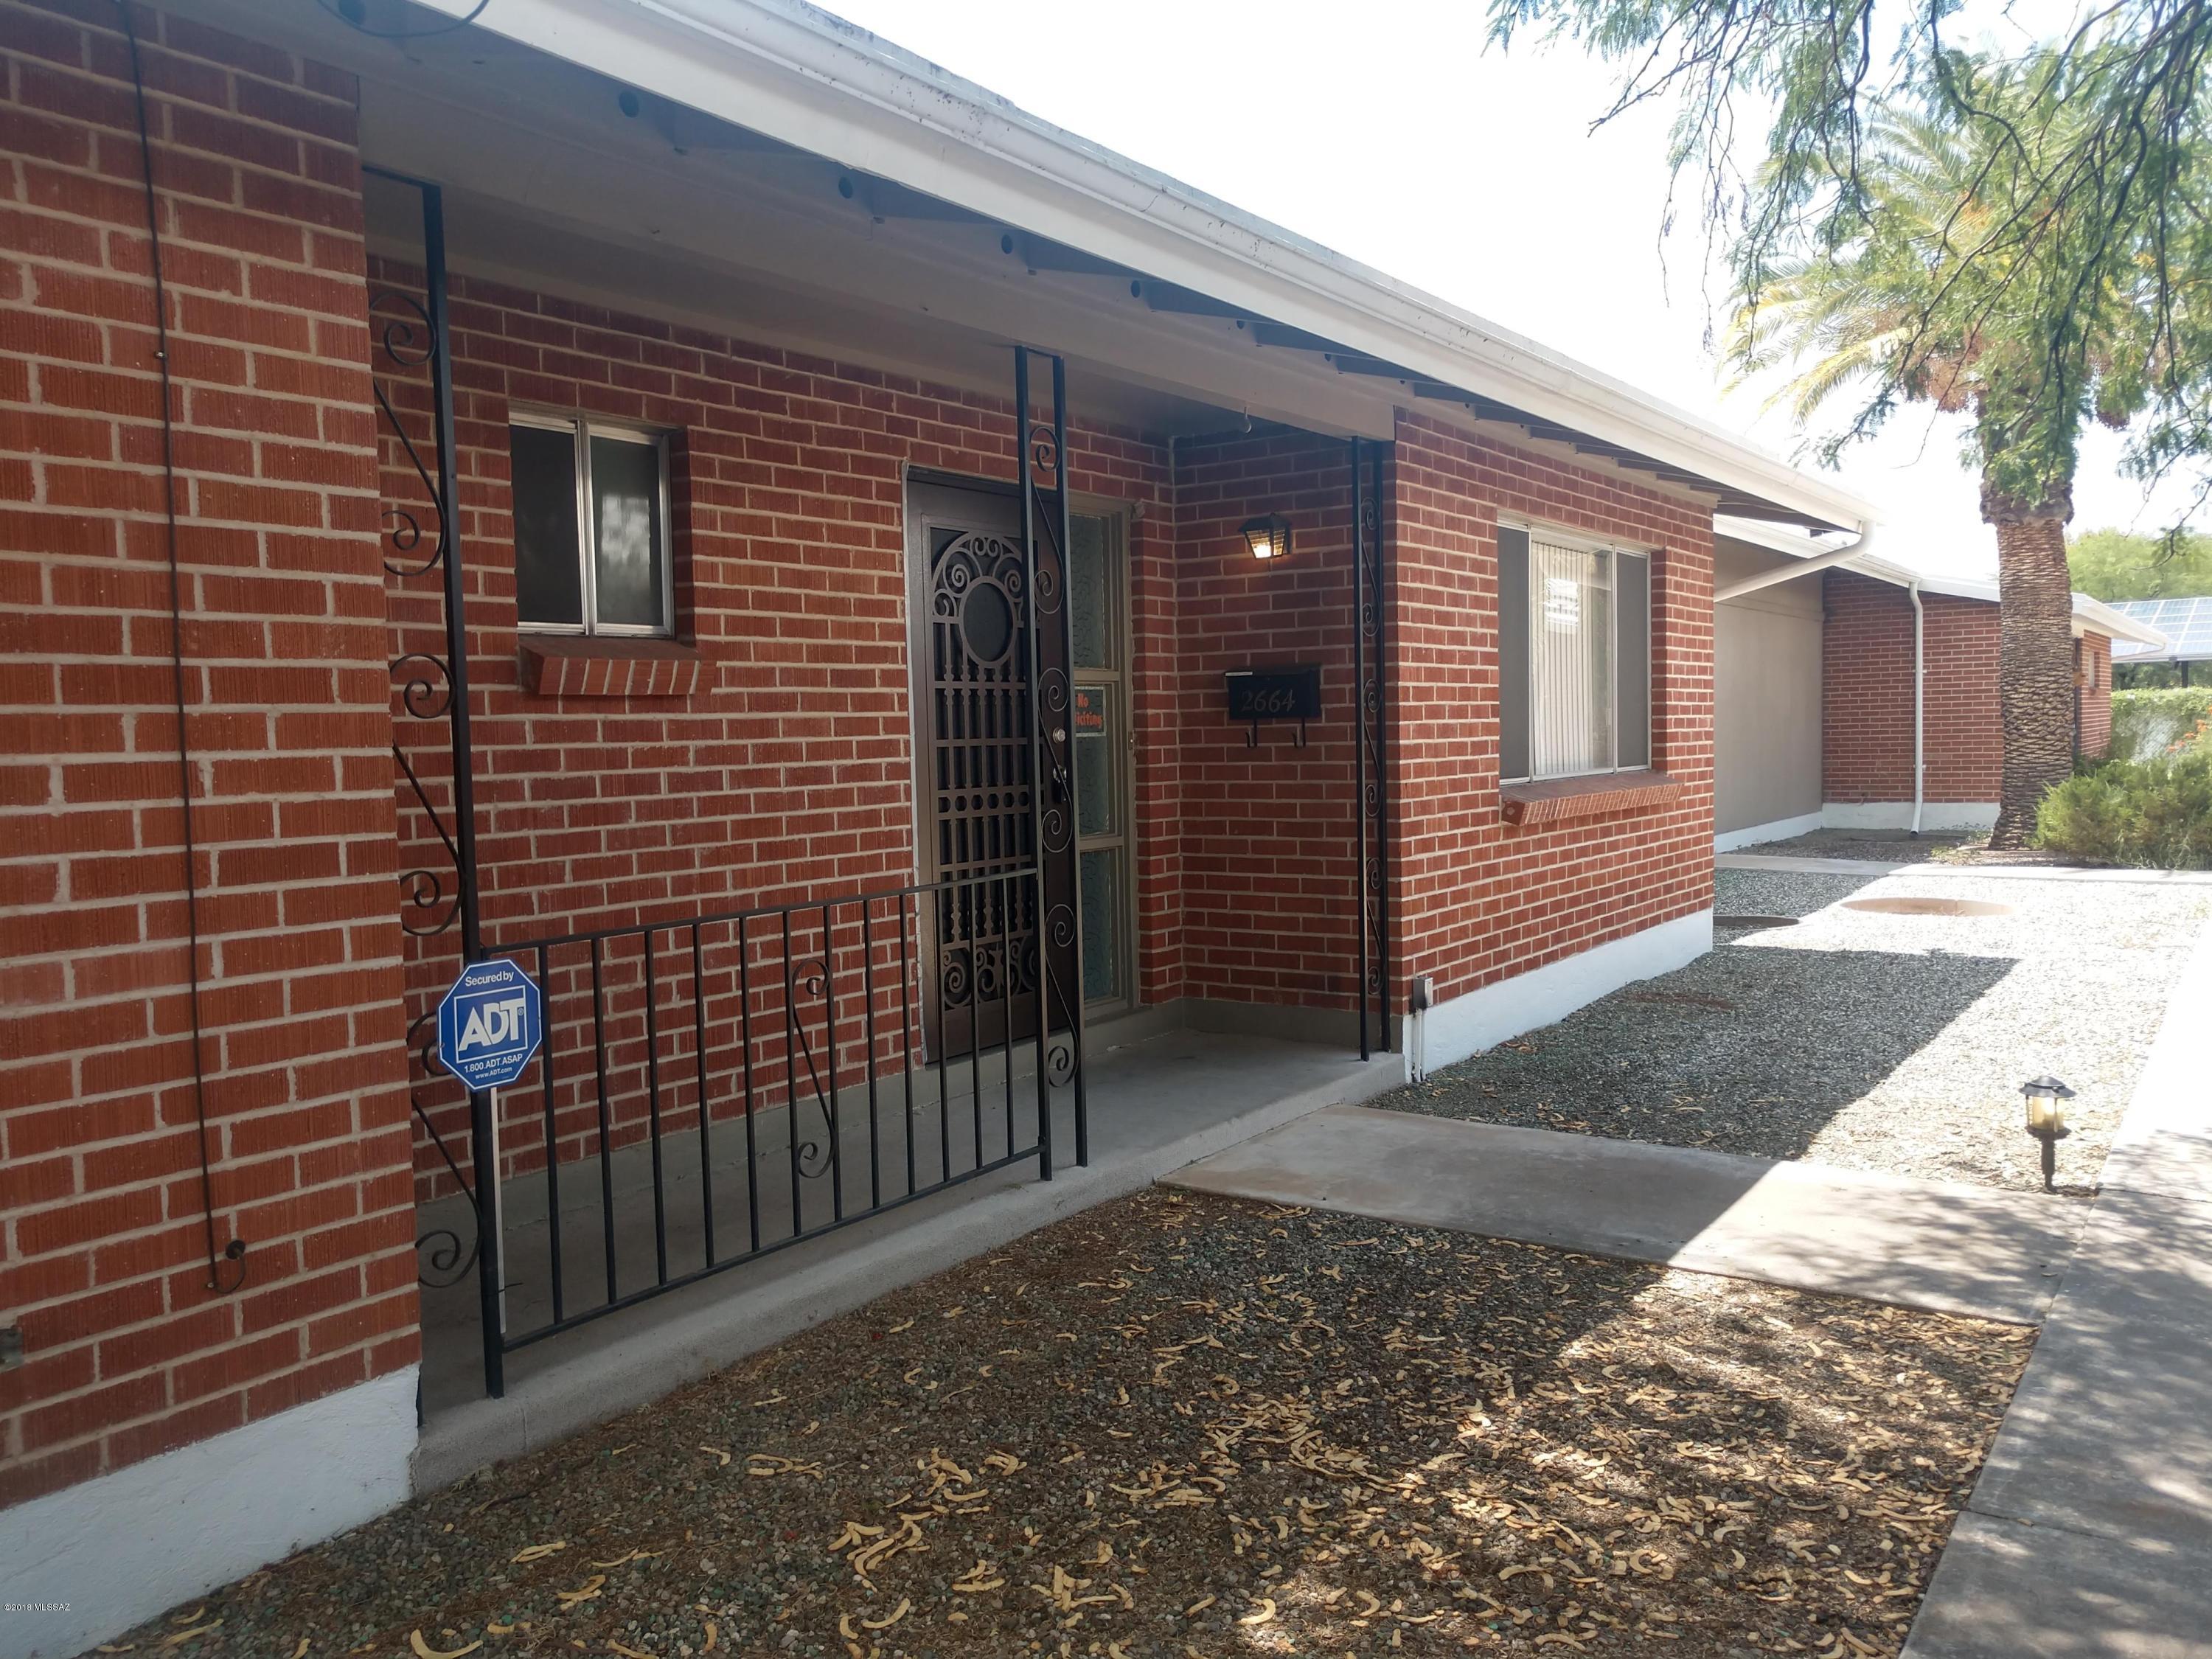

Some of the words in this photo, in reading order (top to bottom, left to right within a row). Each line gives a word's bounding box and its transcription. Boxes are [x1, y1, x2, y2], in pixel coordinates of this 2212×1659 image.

[1077, 692, 1089, 708] No
[1241, 689, 1295, 713] 2664
[465, 971, 502, 987] Secured
[503, 970, 515, 982] by
[458, 998, 526, 1051] ADT
[464, 1054, 523, 1073] 1.800.ADT.ASAP
[475, 1067, 512, 1079] www.ADT.com
